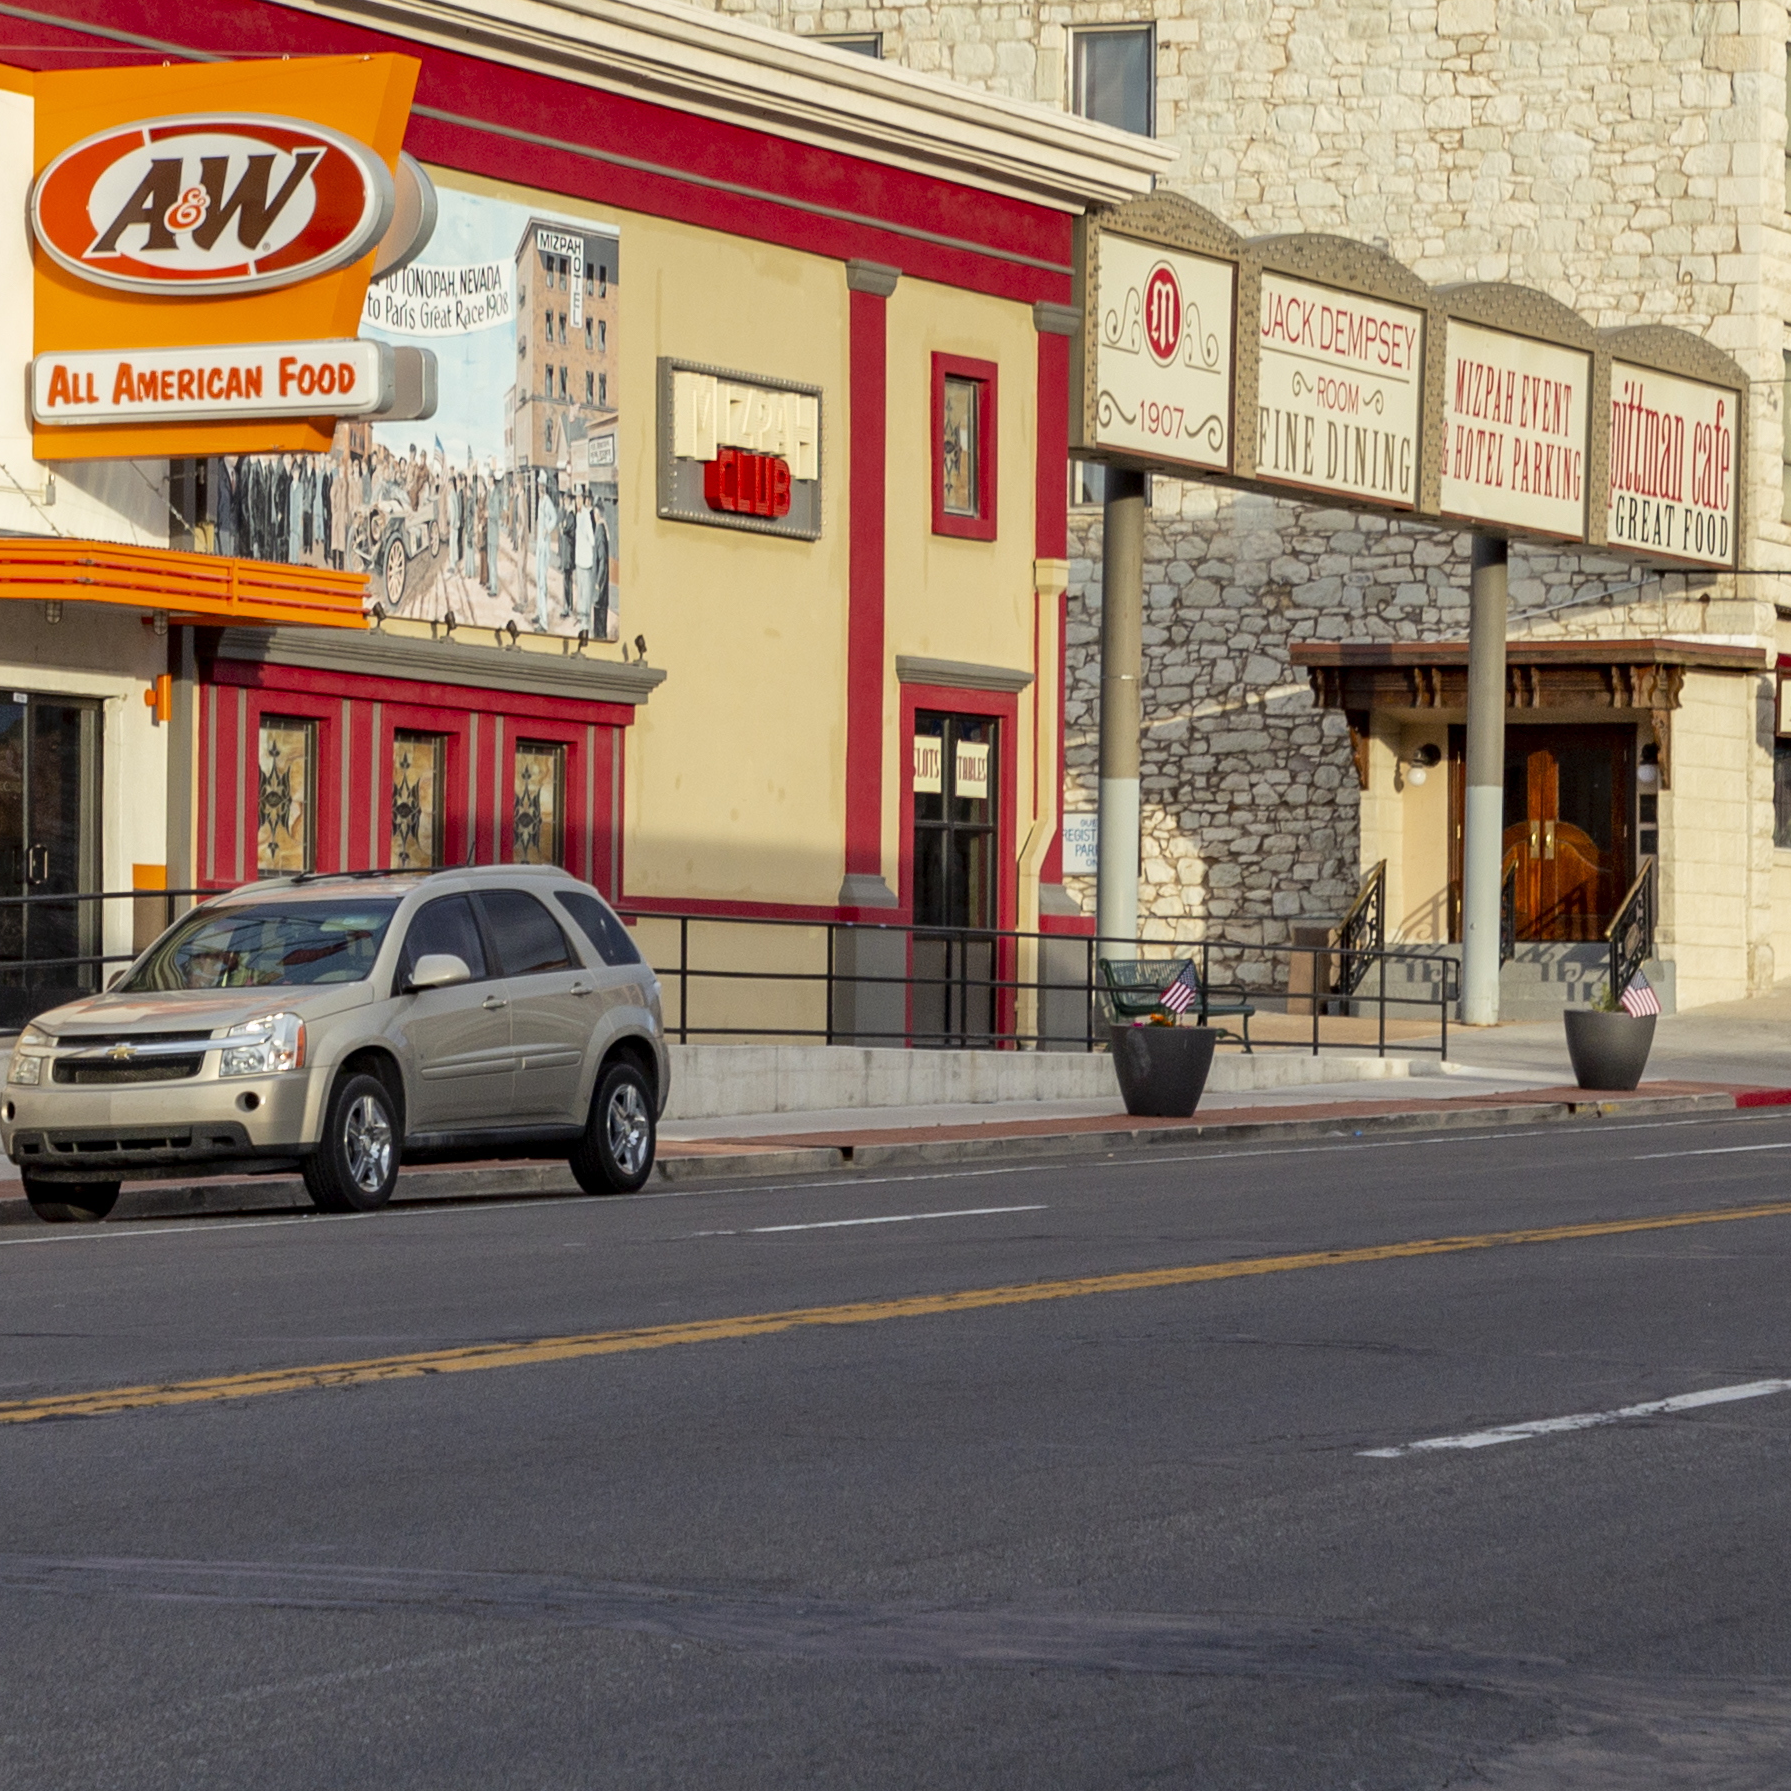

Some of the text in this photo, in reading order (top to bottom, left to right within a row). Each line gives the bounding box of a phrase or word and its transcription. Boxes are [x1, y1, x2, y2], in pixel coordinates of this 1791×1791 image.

[91, 150, 321, 252] A&W
[540, 232, 582, 256] MIZPAH
[385, 294, 416, 330] Paris
[420, 302, 452, 330] Great
[456, 300, 484, 330] Race
[486, 292, 509, 320] 1908
[459, 264, 502, 296] NEVADA
[1262, 292, 1416, 371] JACK DEMPSEY
[47, 356, 356, 408] ALL AMERICAN FOOD
[1317, 376, 1359, 415] ROOM
[1455, 358, 1572, 438] MIZPAH EVENT
[673, 371, 819, 481] MIZPAH
[1139, 399, 1185, 439] 1907
[1259, 406, 1412, 495] FINE DINING
[1608, 380, 1731, 512] pittman cafe
[704, 448, 791, 518] CLUB
[1453, 425, 1504, 488] HOTEL
[1511, 436, 1581, 502] PARKING
[1615, 495, 1729, 558] GREAT FOOD
[957, 756, 986, 782] TABLES
